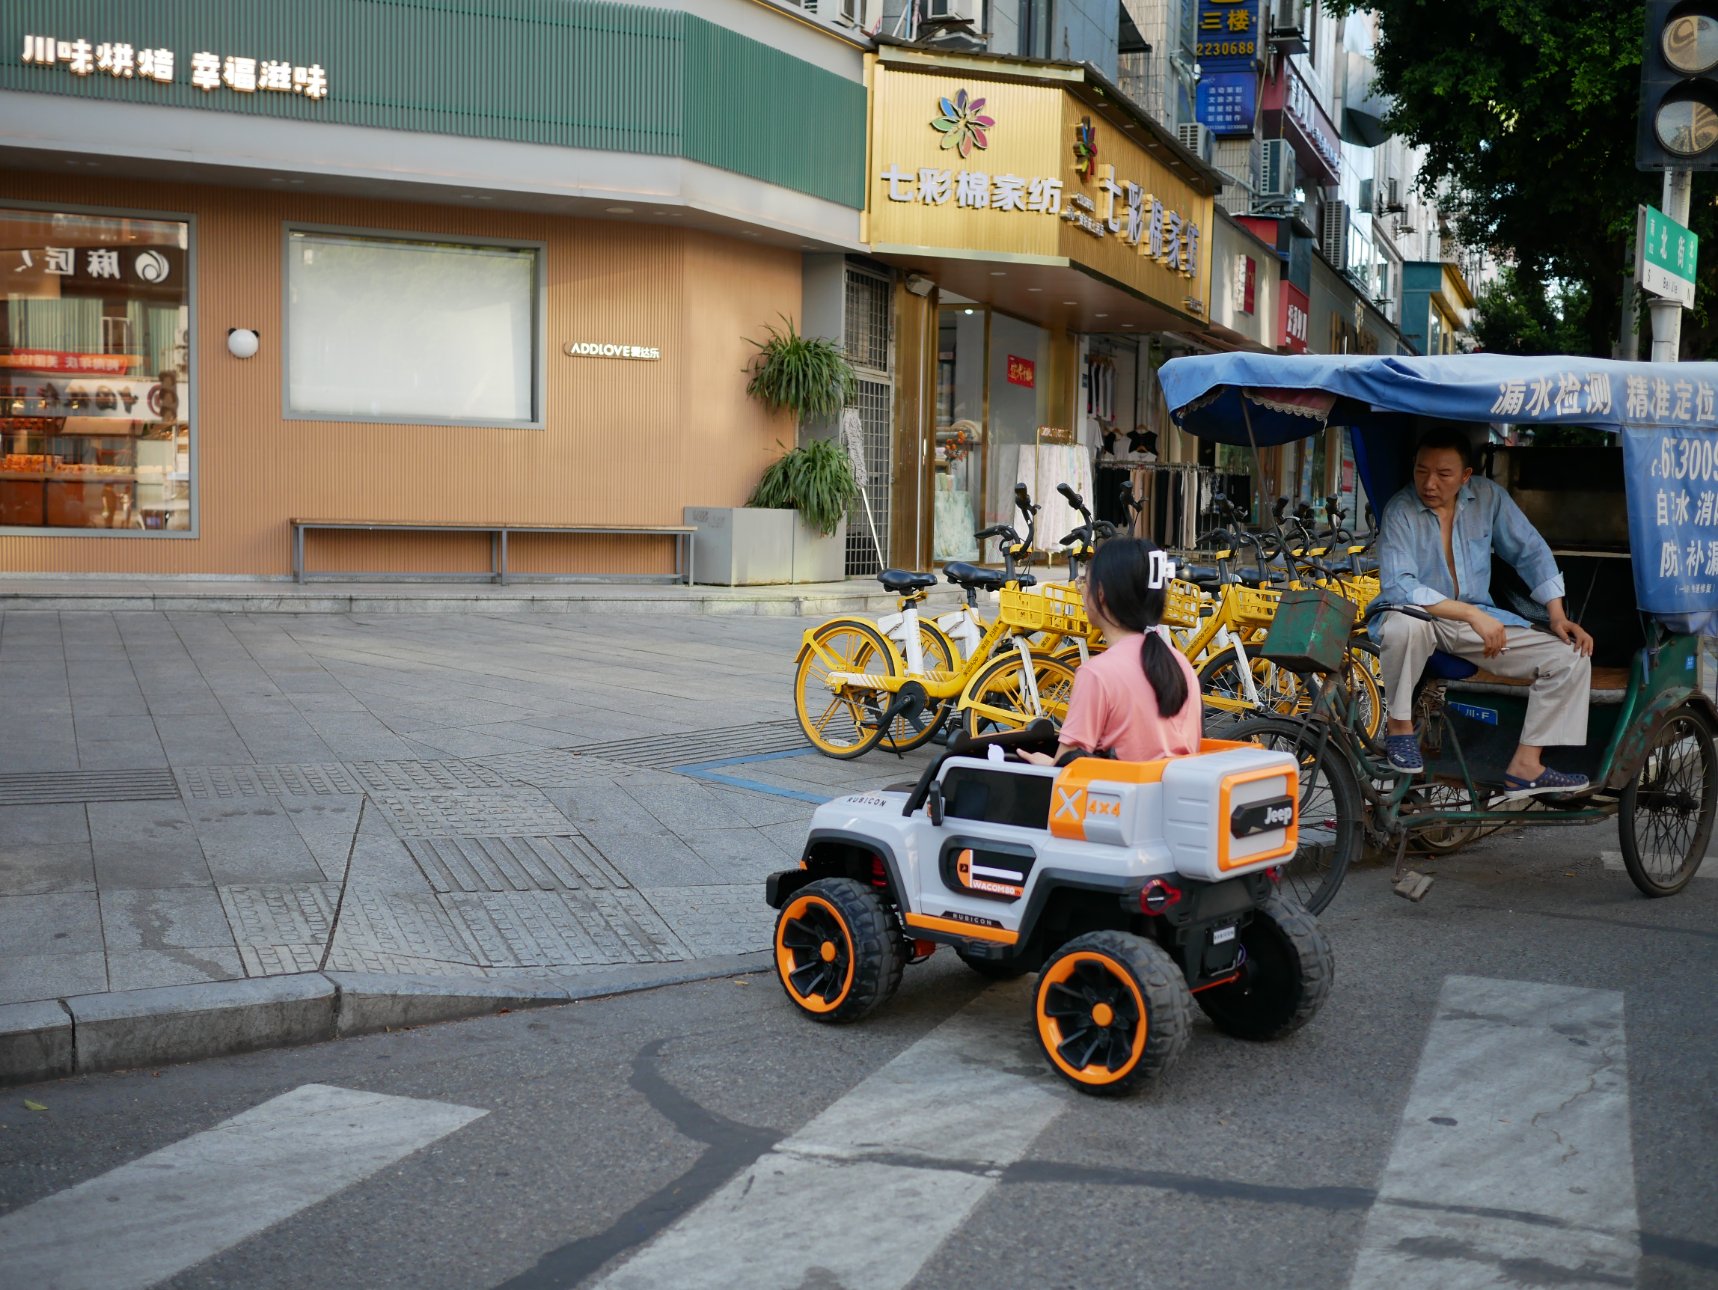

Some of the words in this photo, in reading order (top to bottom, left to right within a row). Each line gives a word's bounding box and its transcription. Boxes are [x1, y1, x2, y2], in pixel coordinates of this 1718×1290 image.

[1201, 10, 1249, 31] 三楼
[1196, 41, 1254, 57] 2230688
[22, 34, 175, 83] 川味烘焙
[190, 51, 328, 100] 幸福滋味
[881, 164, 1063, 215] 七彩棉家纺
[570, 342, 631, 357] ADDLOVE
[1490, 371, 1613, 416] 漏水检测
[1626, 374, 1716, 422] 精准定位
[1656, 488, 1690, 526] 自水
[846, 796, 888, 808] RUBICON
[1264, 806, 1293, 826] Jeep
[952, 912, 993, 927] RUBICON
